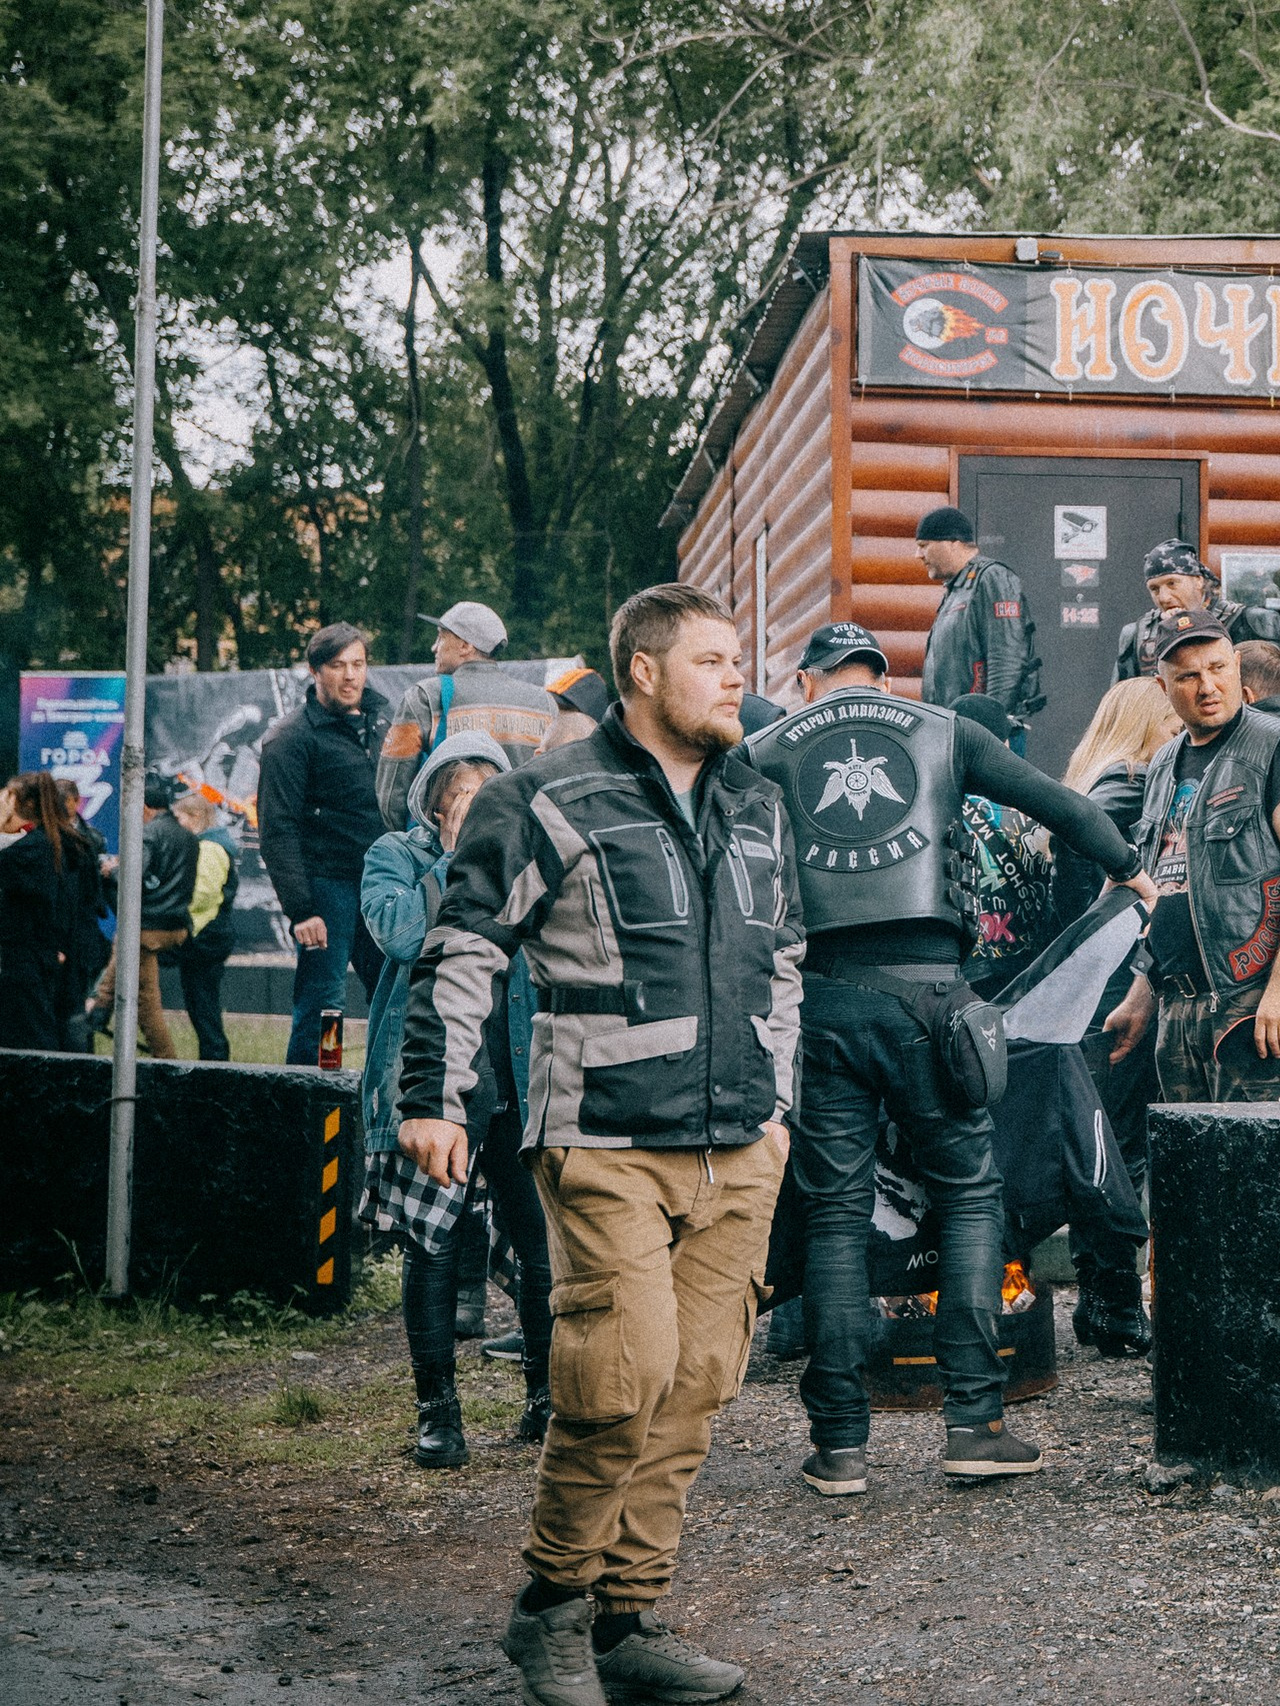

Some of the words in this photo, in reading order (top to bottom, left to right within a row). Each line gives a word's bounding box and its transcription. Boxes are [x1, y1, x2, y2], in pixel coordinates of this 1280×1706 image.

[784, 708, 836, 742] ВТОРОЙ
[837, 703, 915, 729] ДИВИЗИОН
[804, 830, 924, 870] РОССИЯ
